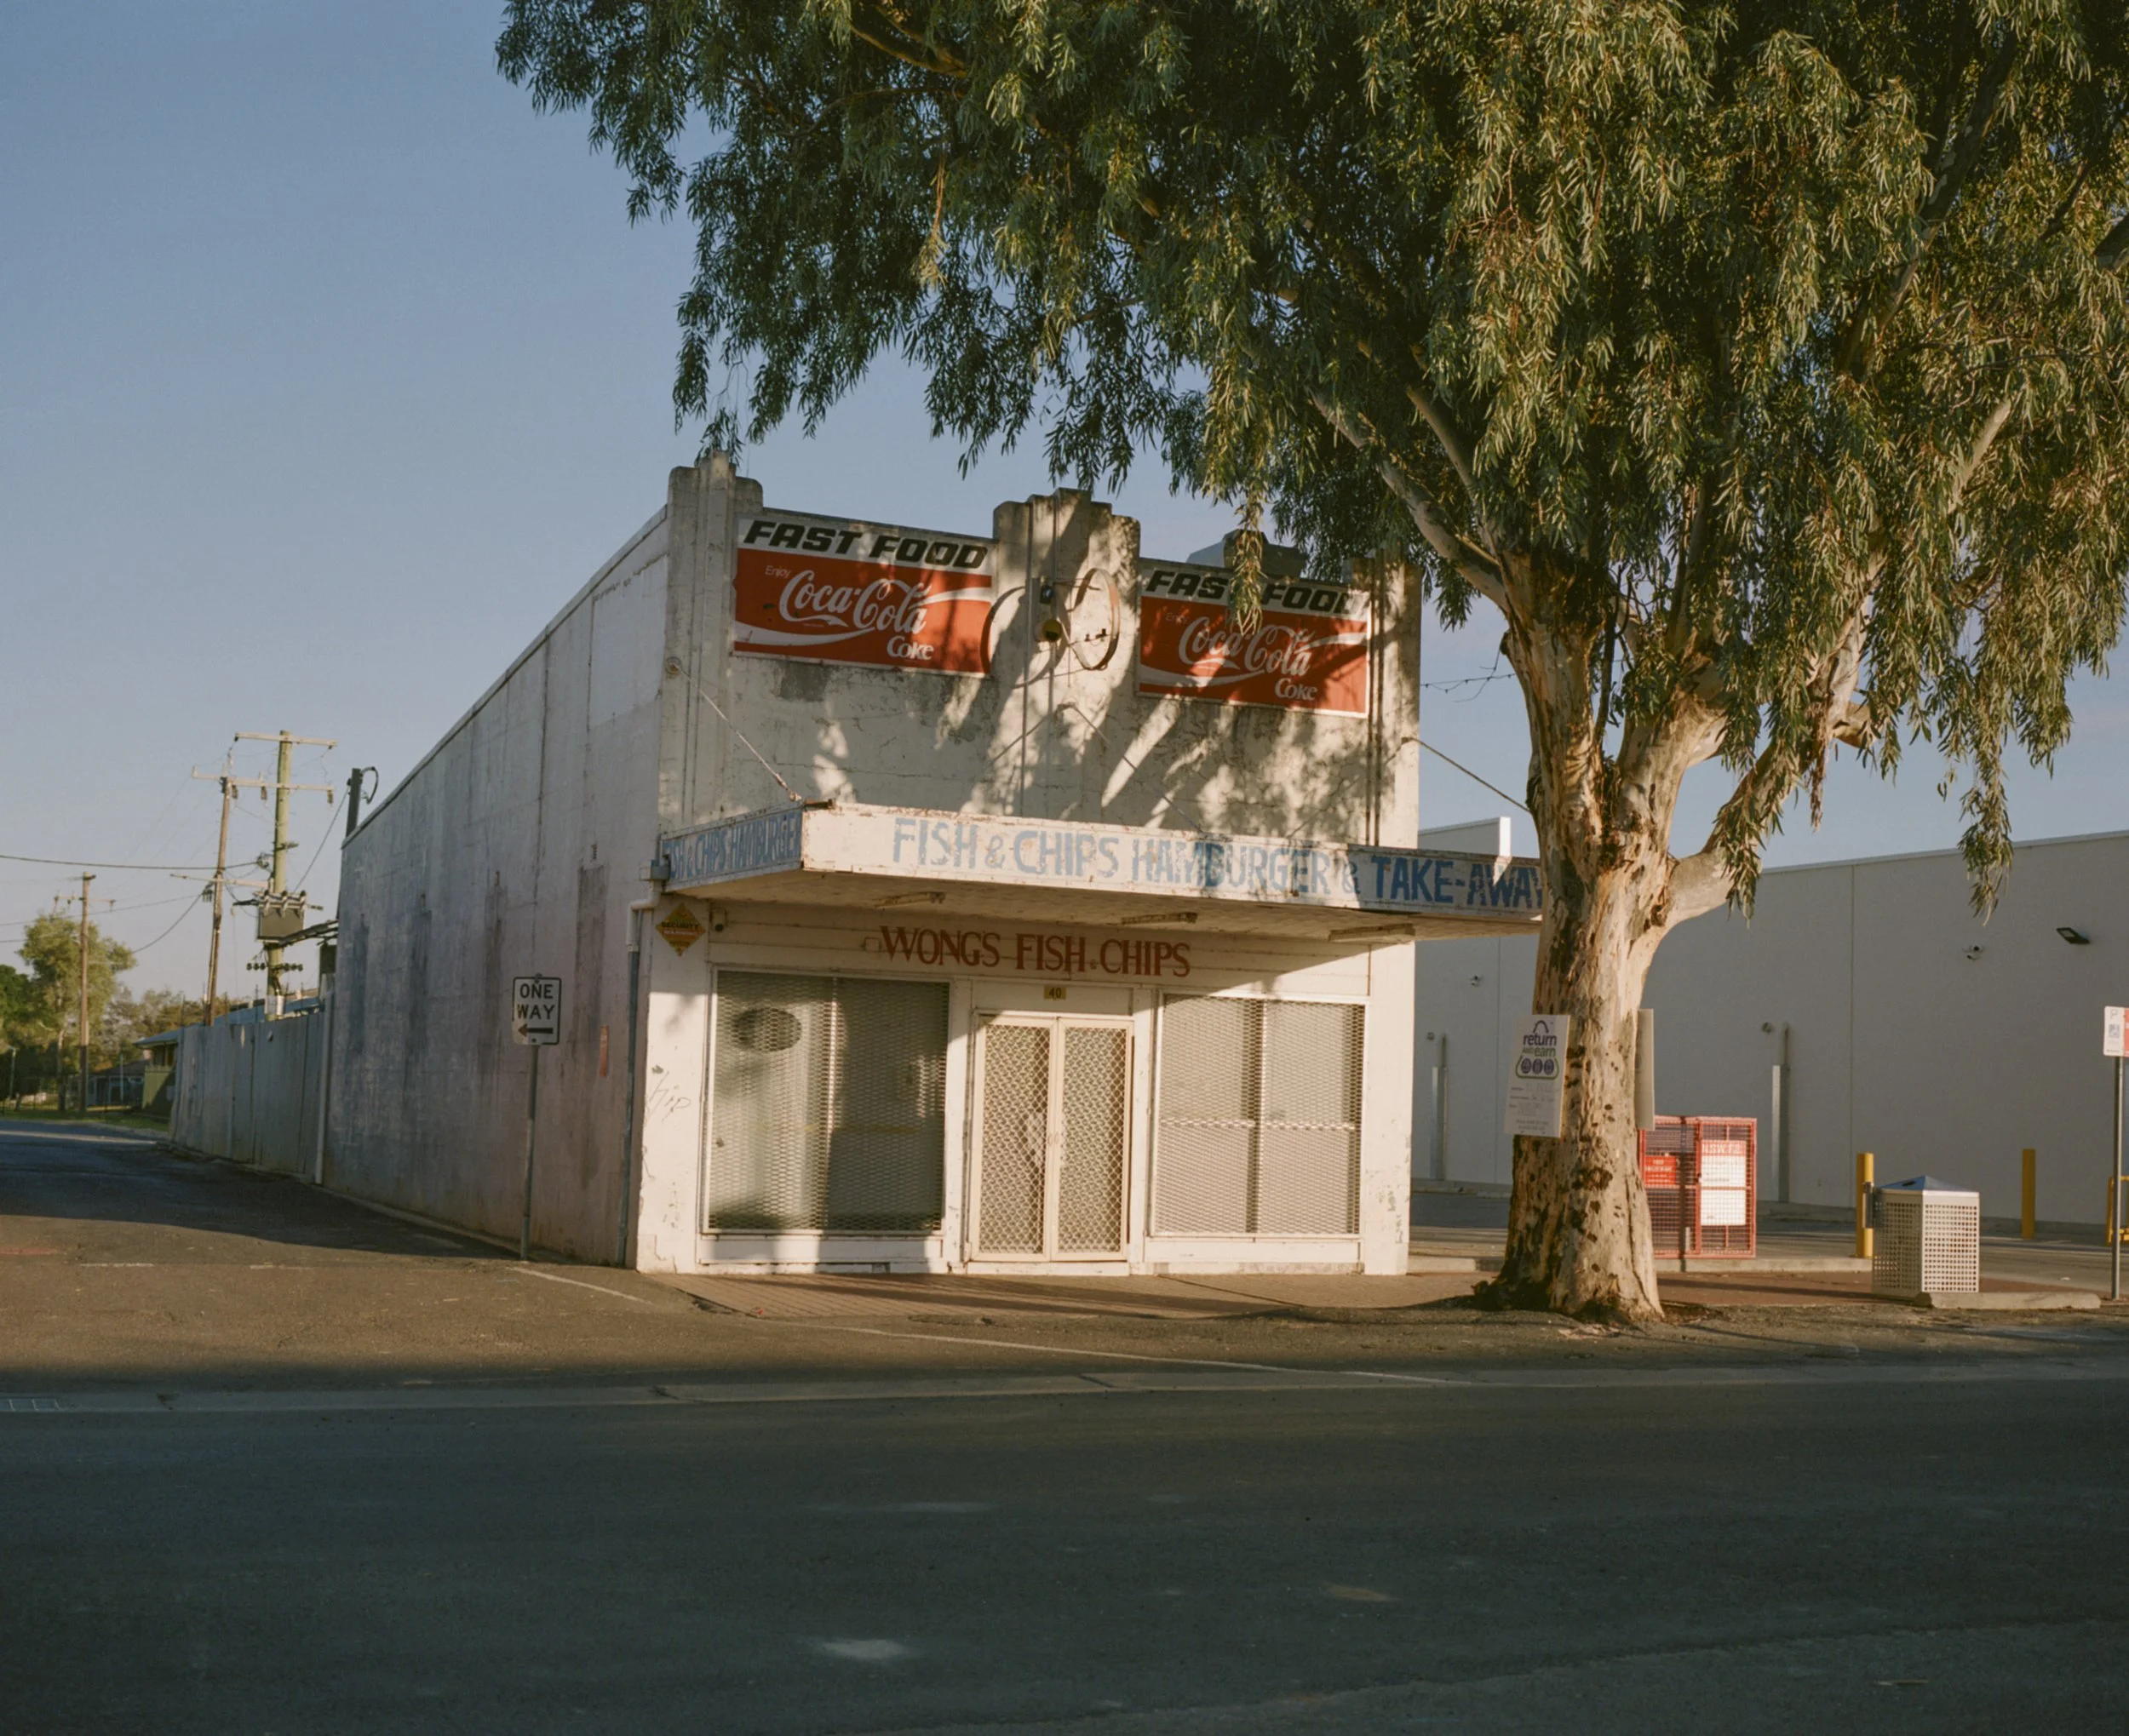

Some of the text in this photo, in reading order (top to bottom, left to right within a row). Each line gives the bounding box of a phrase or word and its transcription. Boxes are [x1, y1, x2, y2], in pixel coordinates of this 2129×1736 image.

[743, 520, 988, 569] FAST FOOD
[765, 565, 791, 579] Enjoy
[1146, 570, 1235, 601] FAS
[779, 570, 933, 634] Coca-Cola
[887, 635, 934, 661] Coke
[1275, 680, 1317, 701] Coke
[892, 816, 978, 869] FISH
[984, 834, 1005, 869] &
[1013, 829, 1120, 879] CHIPS
[1132, 837, 1330, 895] HAMBURGER
[1341, 857, 1362, 896] &
[1015, 933, 1086, 973] FISH
[1099, 938, 1191, 978] CHIPS
[519, 983, 554, 1000] ONE
[1048, 987, 1062, 999] 40
[517, 1004, 555, 1020] WAY
[1523, 1033, 1558, 1046] return
[1535, 1047, 1556, 1057] earn
